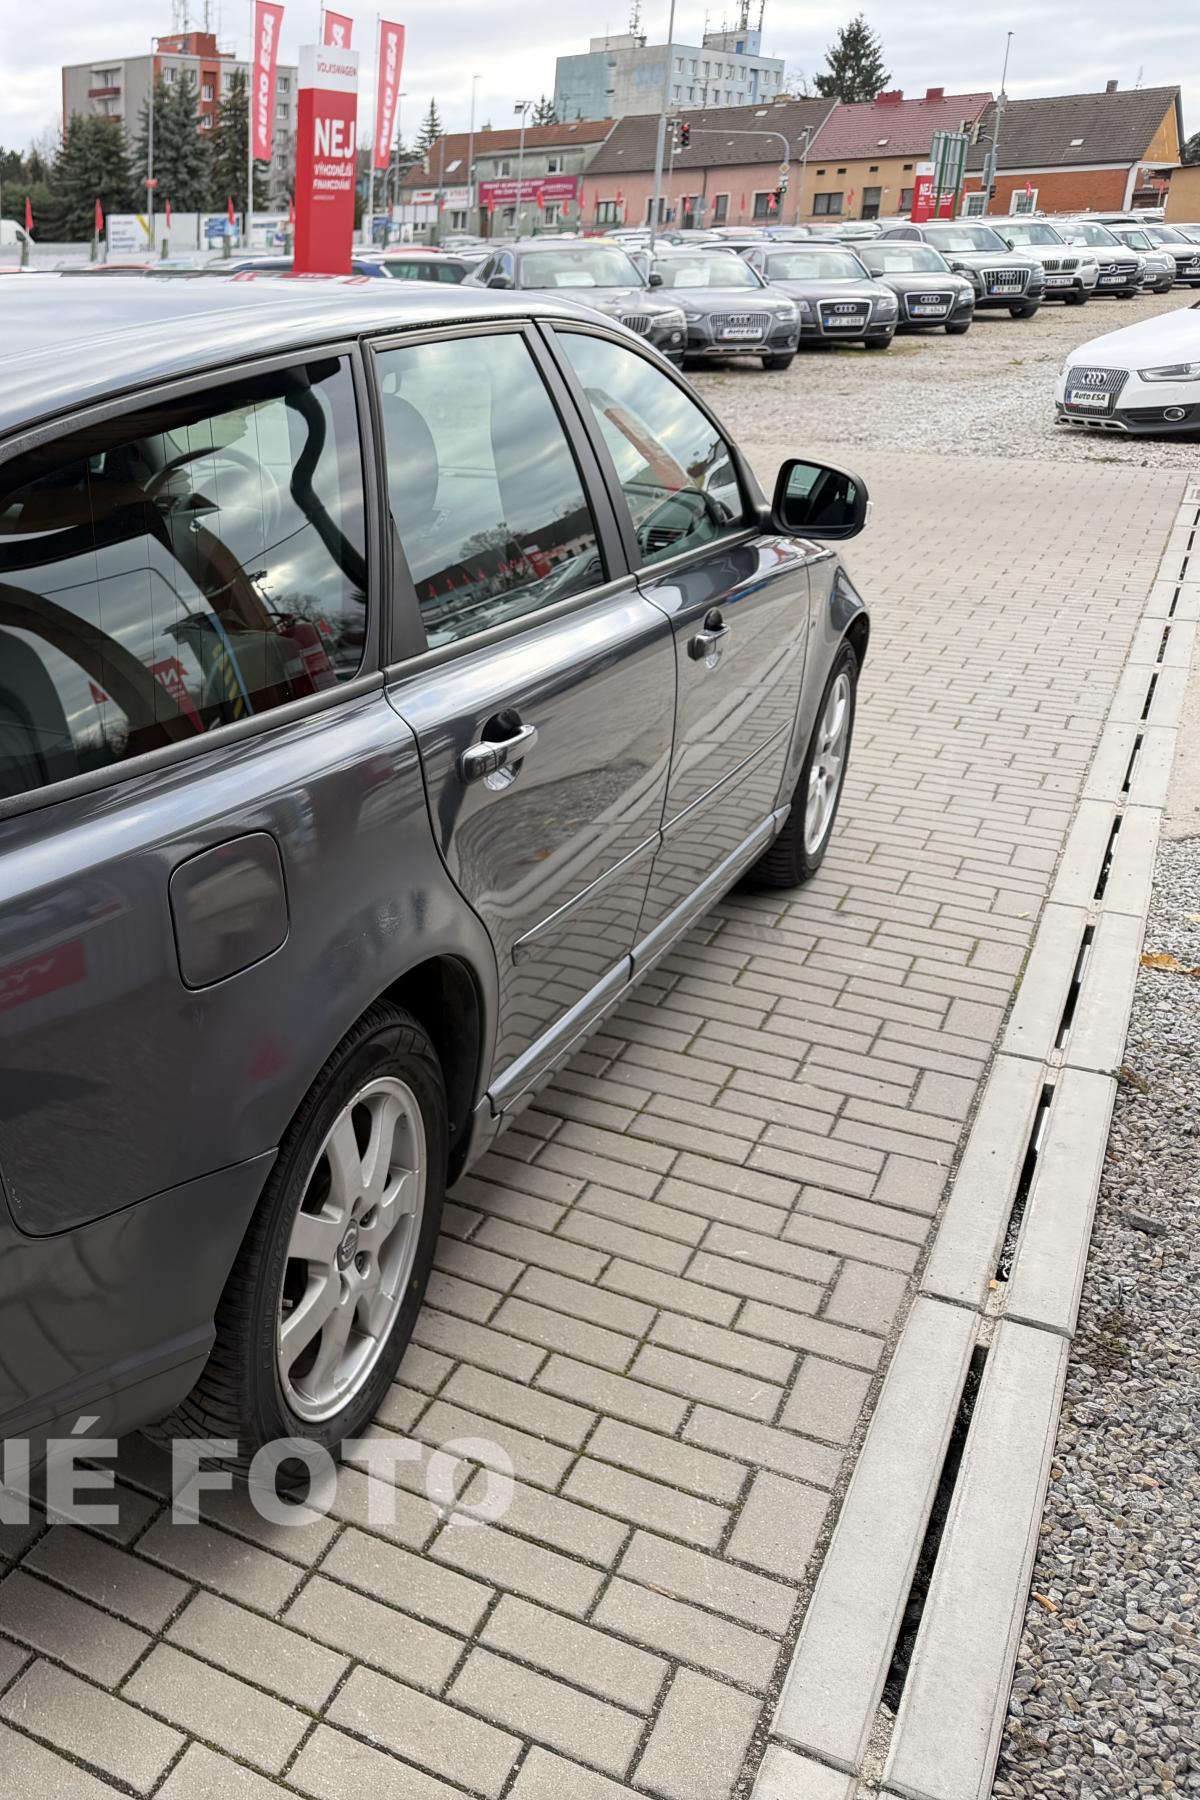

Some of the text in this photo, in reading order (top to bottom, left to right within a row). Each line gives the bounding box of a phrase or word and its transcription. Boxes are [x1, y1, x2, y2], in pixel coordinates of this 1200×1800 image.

[316, 61, 357, 78] VOLKSWAGEN
[386, 32, 398, 85] ESA
[258, 12, 275, 148] AUTO ESA
[313, 117, 356, 158] NEJ
[1073, 391, 1106, 401] Auto ESA
